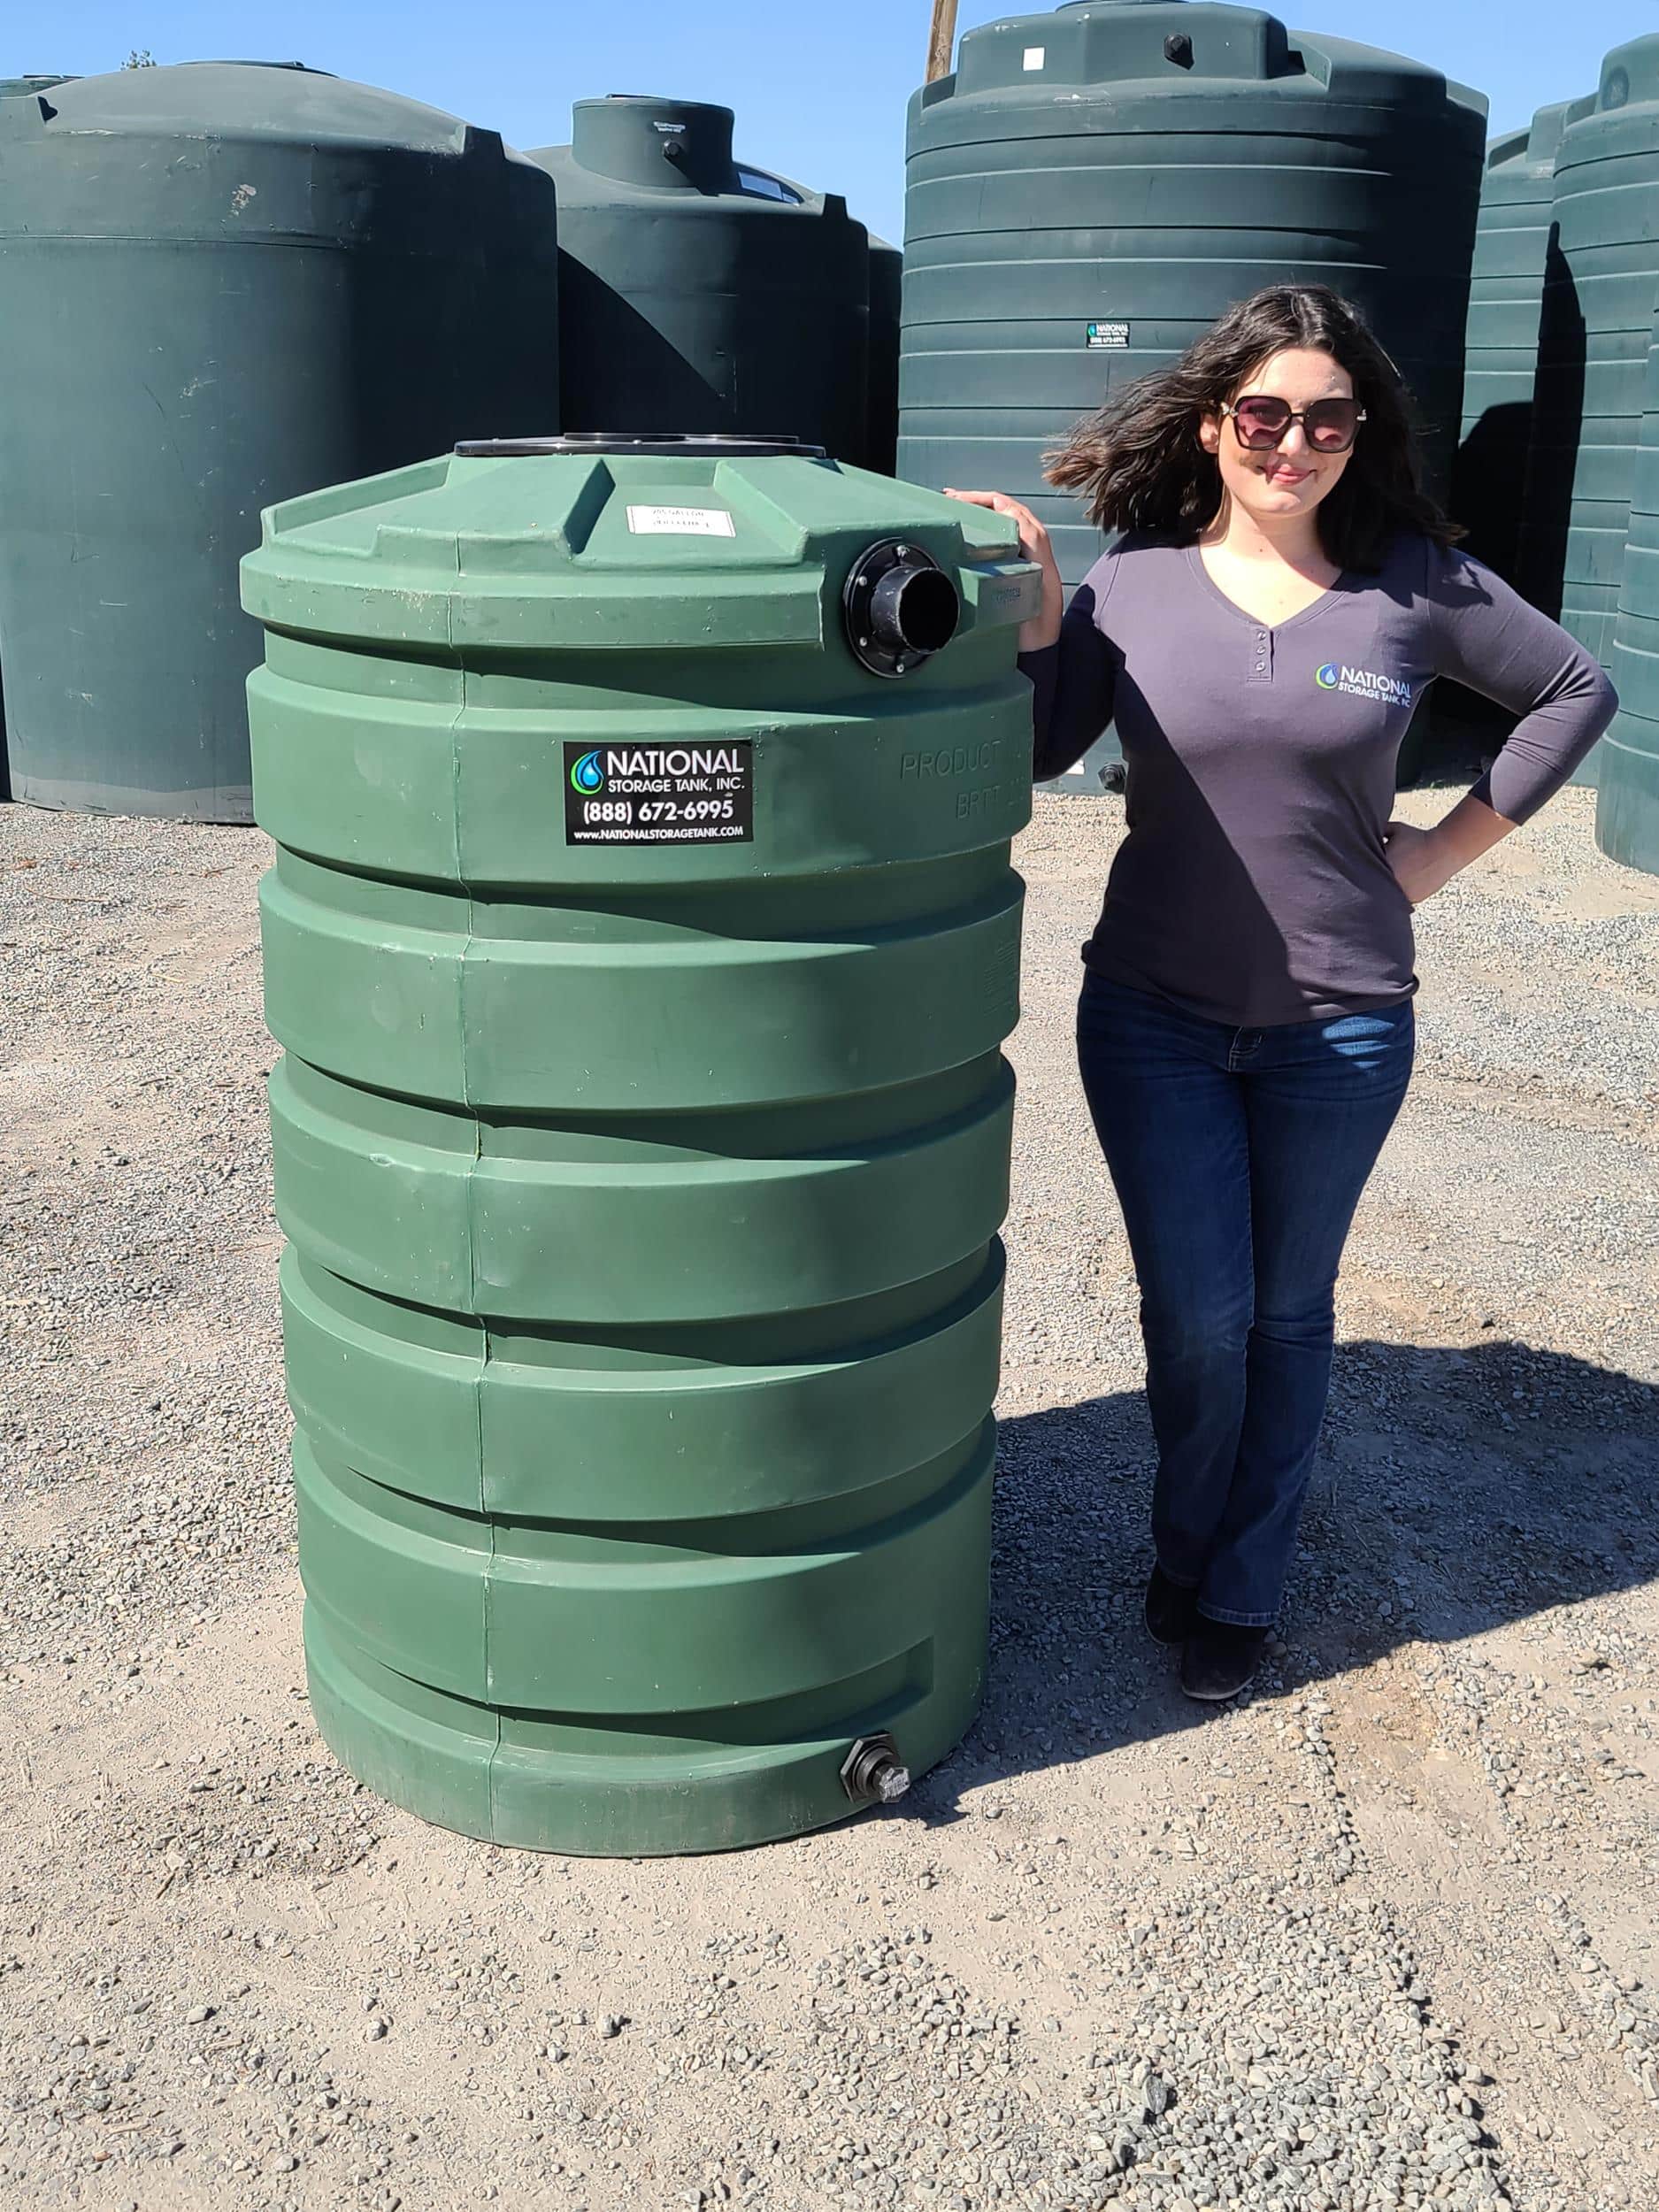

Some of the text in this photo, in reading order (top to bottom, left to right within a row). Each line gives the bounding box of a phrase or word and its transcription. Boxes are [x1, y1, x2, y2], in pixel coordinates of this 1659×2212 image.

[1338, 681, 1380, 700] STORAGE
[1340, 665, 1411, 698] NATIONAL
[607, 749, 744, 776] NATIONAL
[900, 739, 1002, 780] PRODUCT
[608, 777, 745, 793] STORAGE TANK, INC.
[583, 800, 733, 825] (888) 672-6995
[574, 826, 744, 840] www.NATIONALSTORAGETANK.COM
